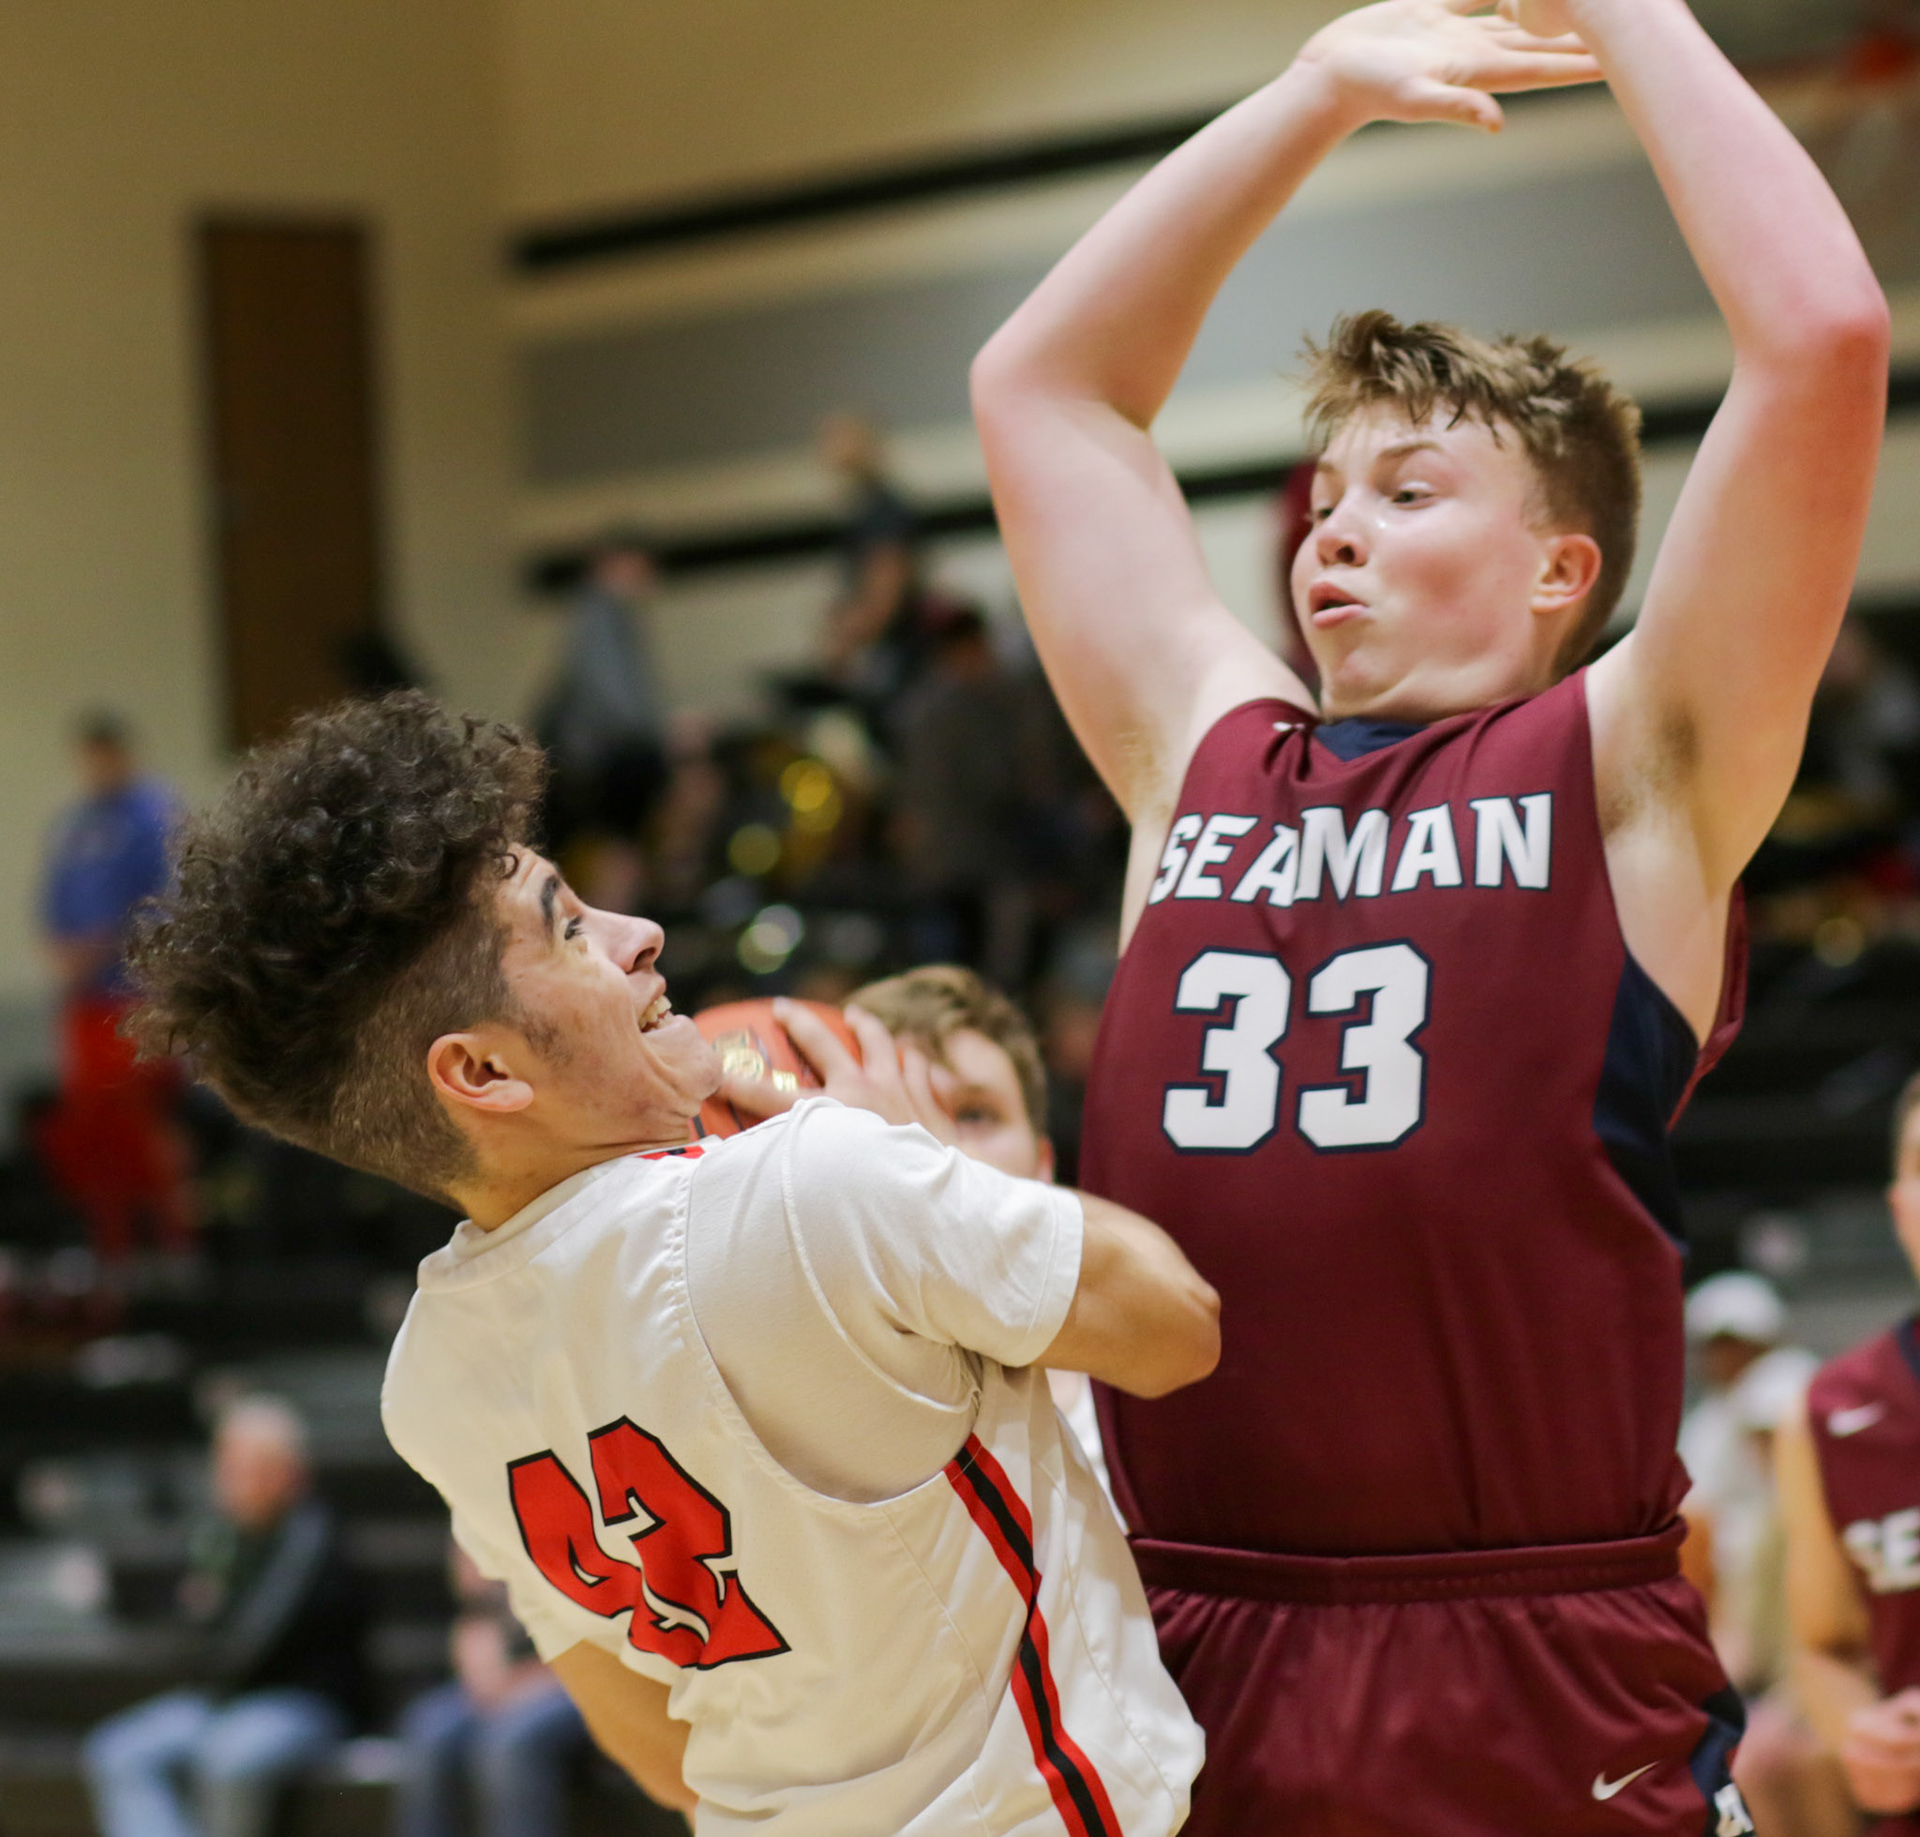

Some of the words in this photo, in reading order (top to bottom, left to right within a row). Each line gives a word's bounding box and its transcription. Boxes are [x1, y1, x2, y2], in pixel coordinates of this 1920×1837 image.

[1147, 791, 1552, 908] SEAMAN
[1161, 938, 1434, 1156] 33
[506, 1414, 792, 1670] 42
